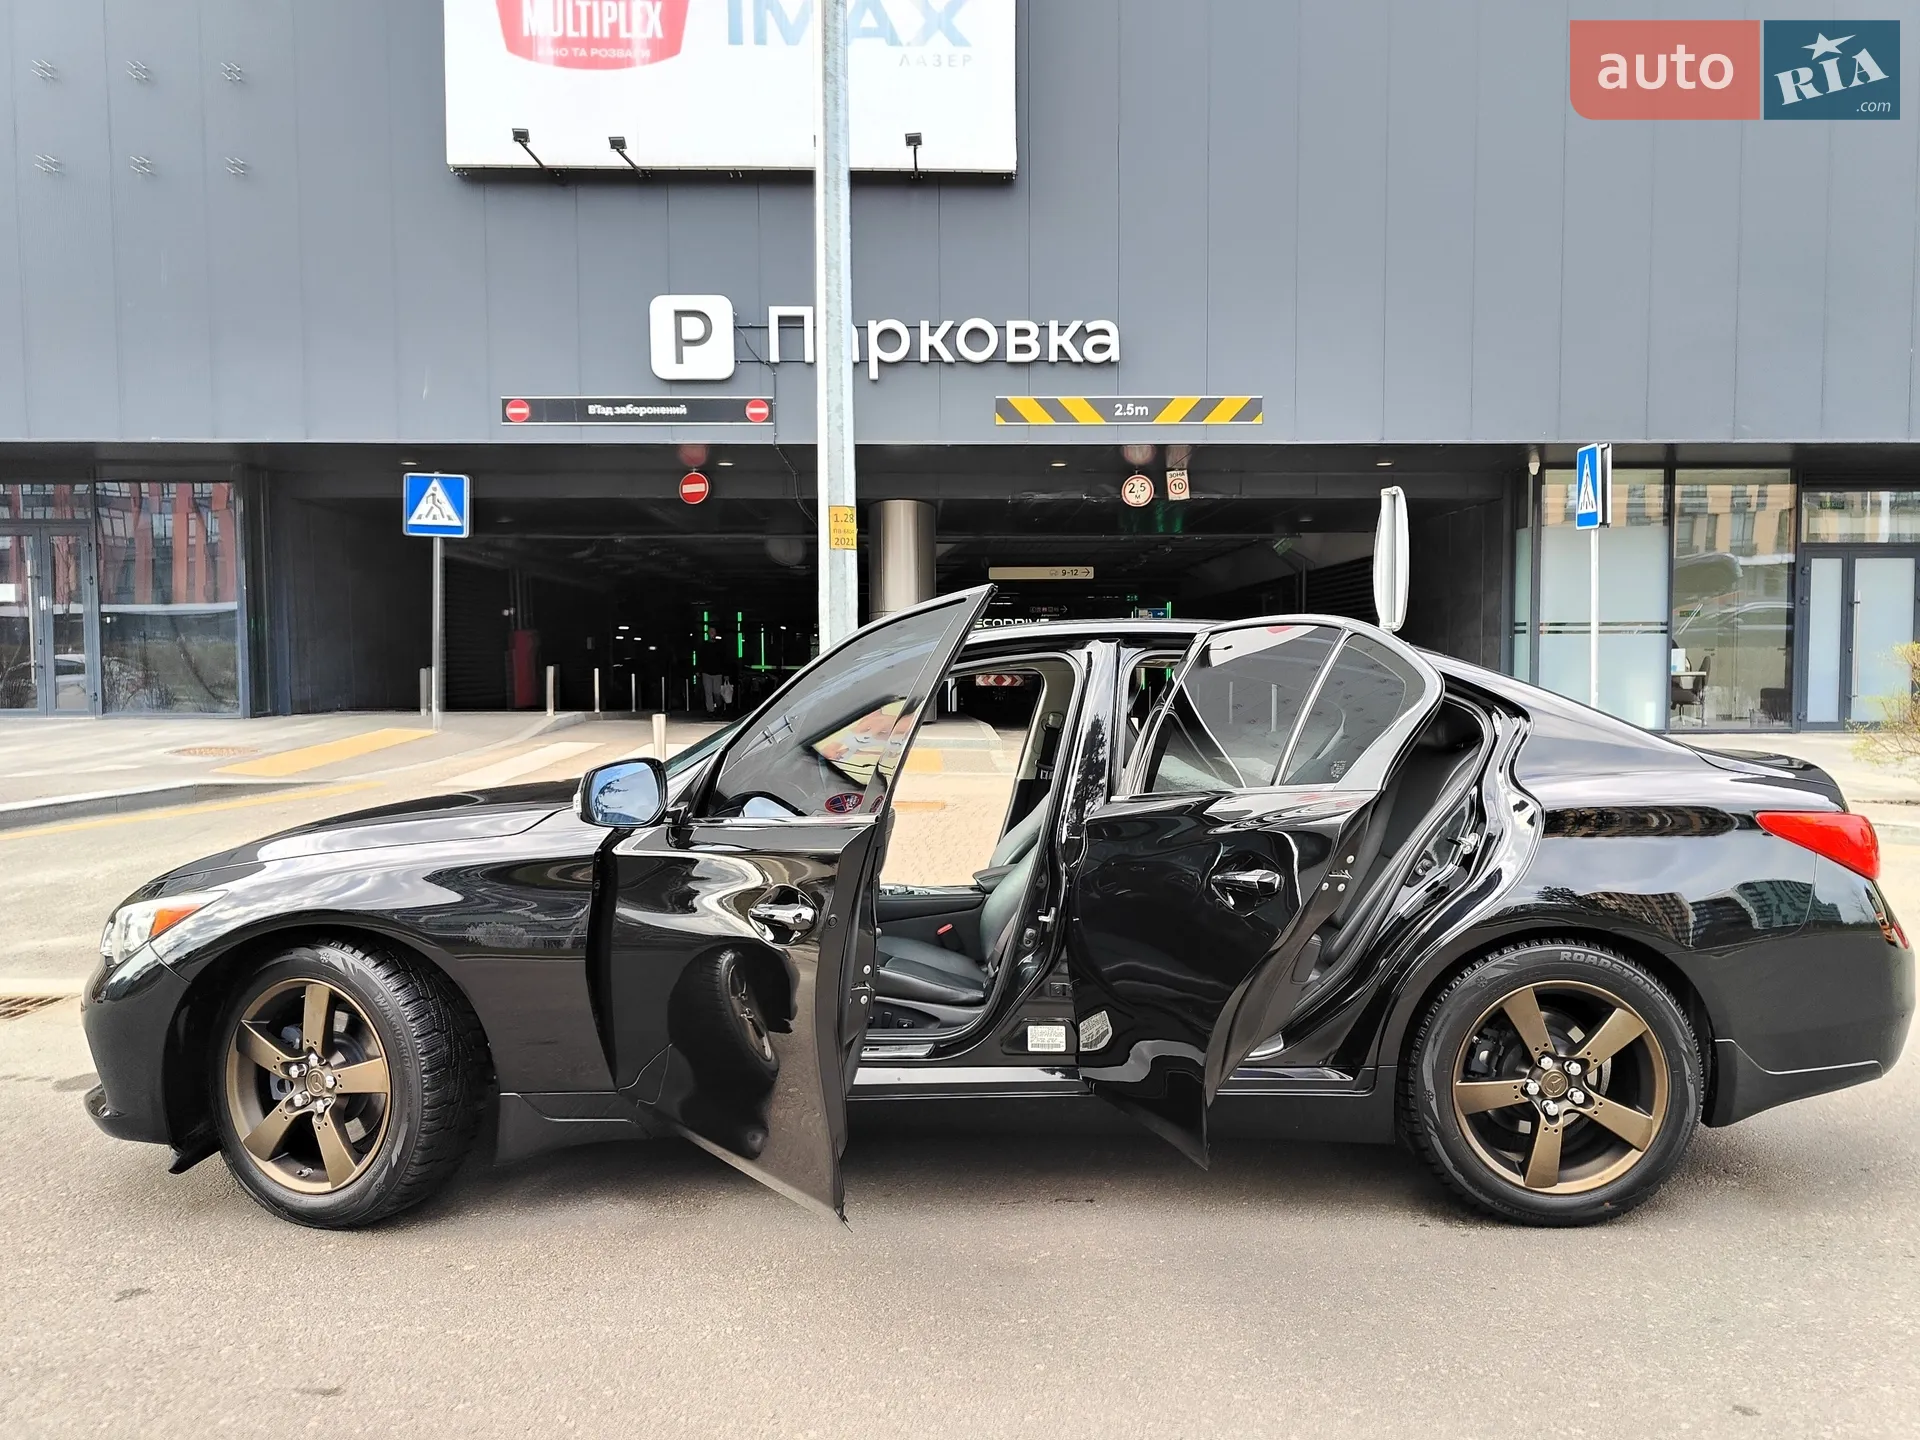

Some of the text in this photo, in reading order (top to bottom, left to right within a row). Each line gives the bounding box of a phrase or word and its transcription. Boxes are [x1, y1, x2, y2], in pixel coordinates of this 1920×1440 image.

[522, 0, 664, 38] MULTIPLEX
[538, 47, 650, 58] НО ТА РОЗВАИ
[899, 54, 972, 67] ЛАЗЕР
[768, 306, 1121, 381] Прковка
[614, 404, 688, 416] заборонений
[1173, 482, 1184, 491] 10
[833, 513, 855, 523] 1.28
[834, 537, 855, 546] 2021
[1560, 951, 1664, 1002] ROADSTONE
